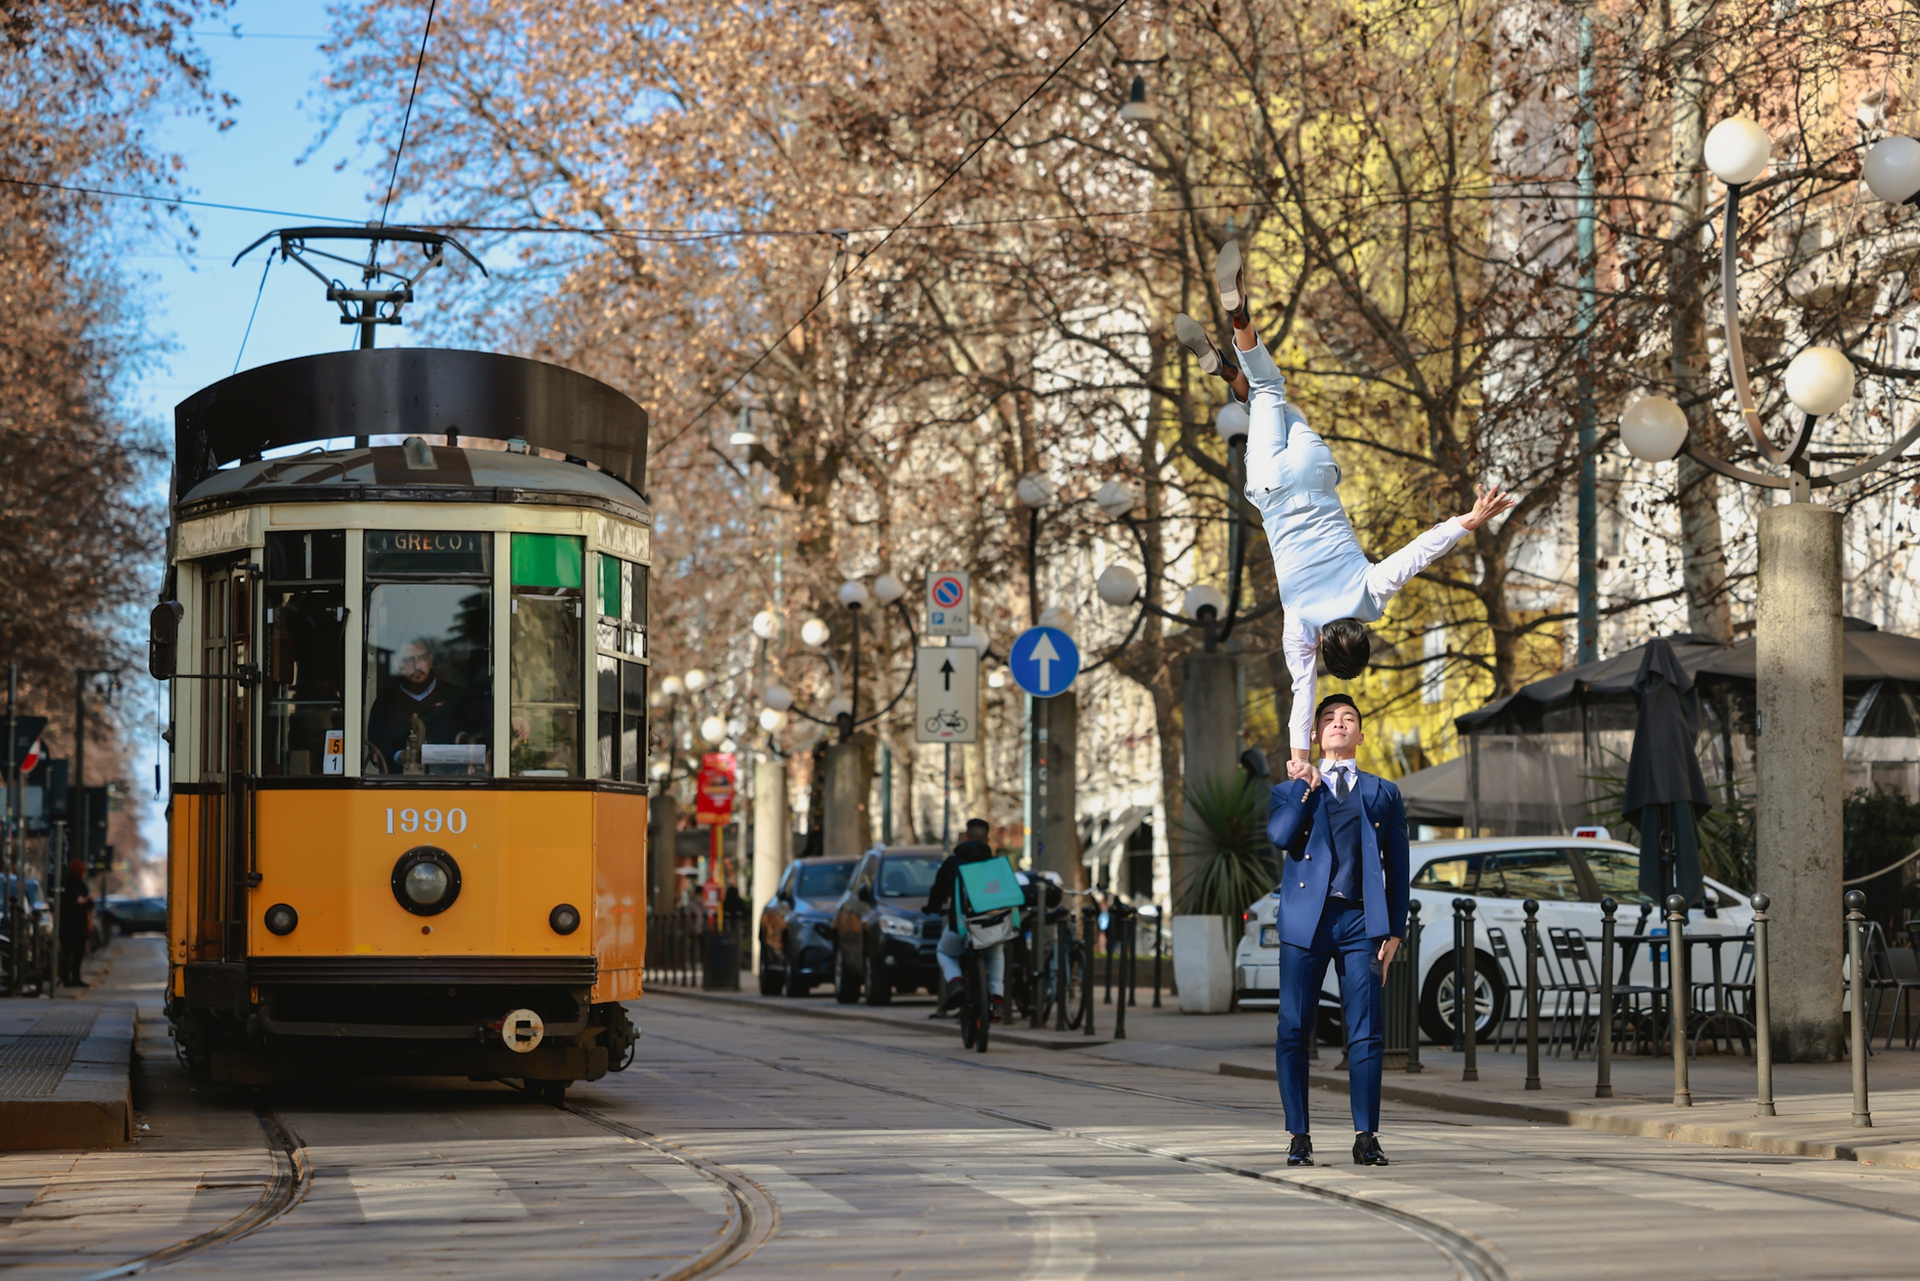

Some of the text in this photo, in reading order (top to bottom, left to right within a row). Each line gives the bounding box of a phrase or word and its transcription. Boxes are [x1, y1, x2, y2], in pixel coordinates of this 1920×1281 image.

[394, 532, 463, 551] GRECO
[332, 739, 341, 754] 5
[331, 756, 338, 771] 1
[385, 807, 468, 835] 1990
